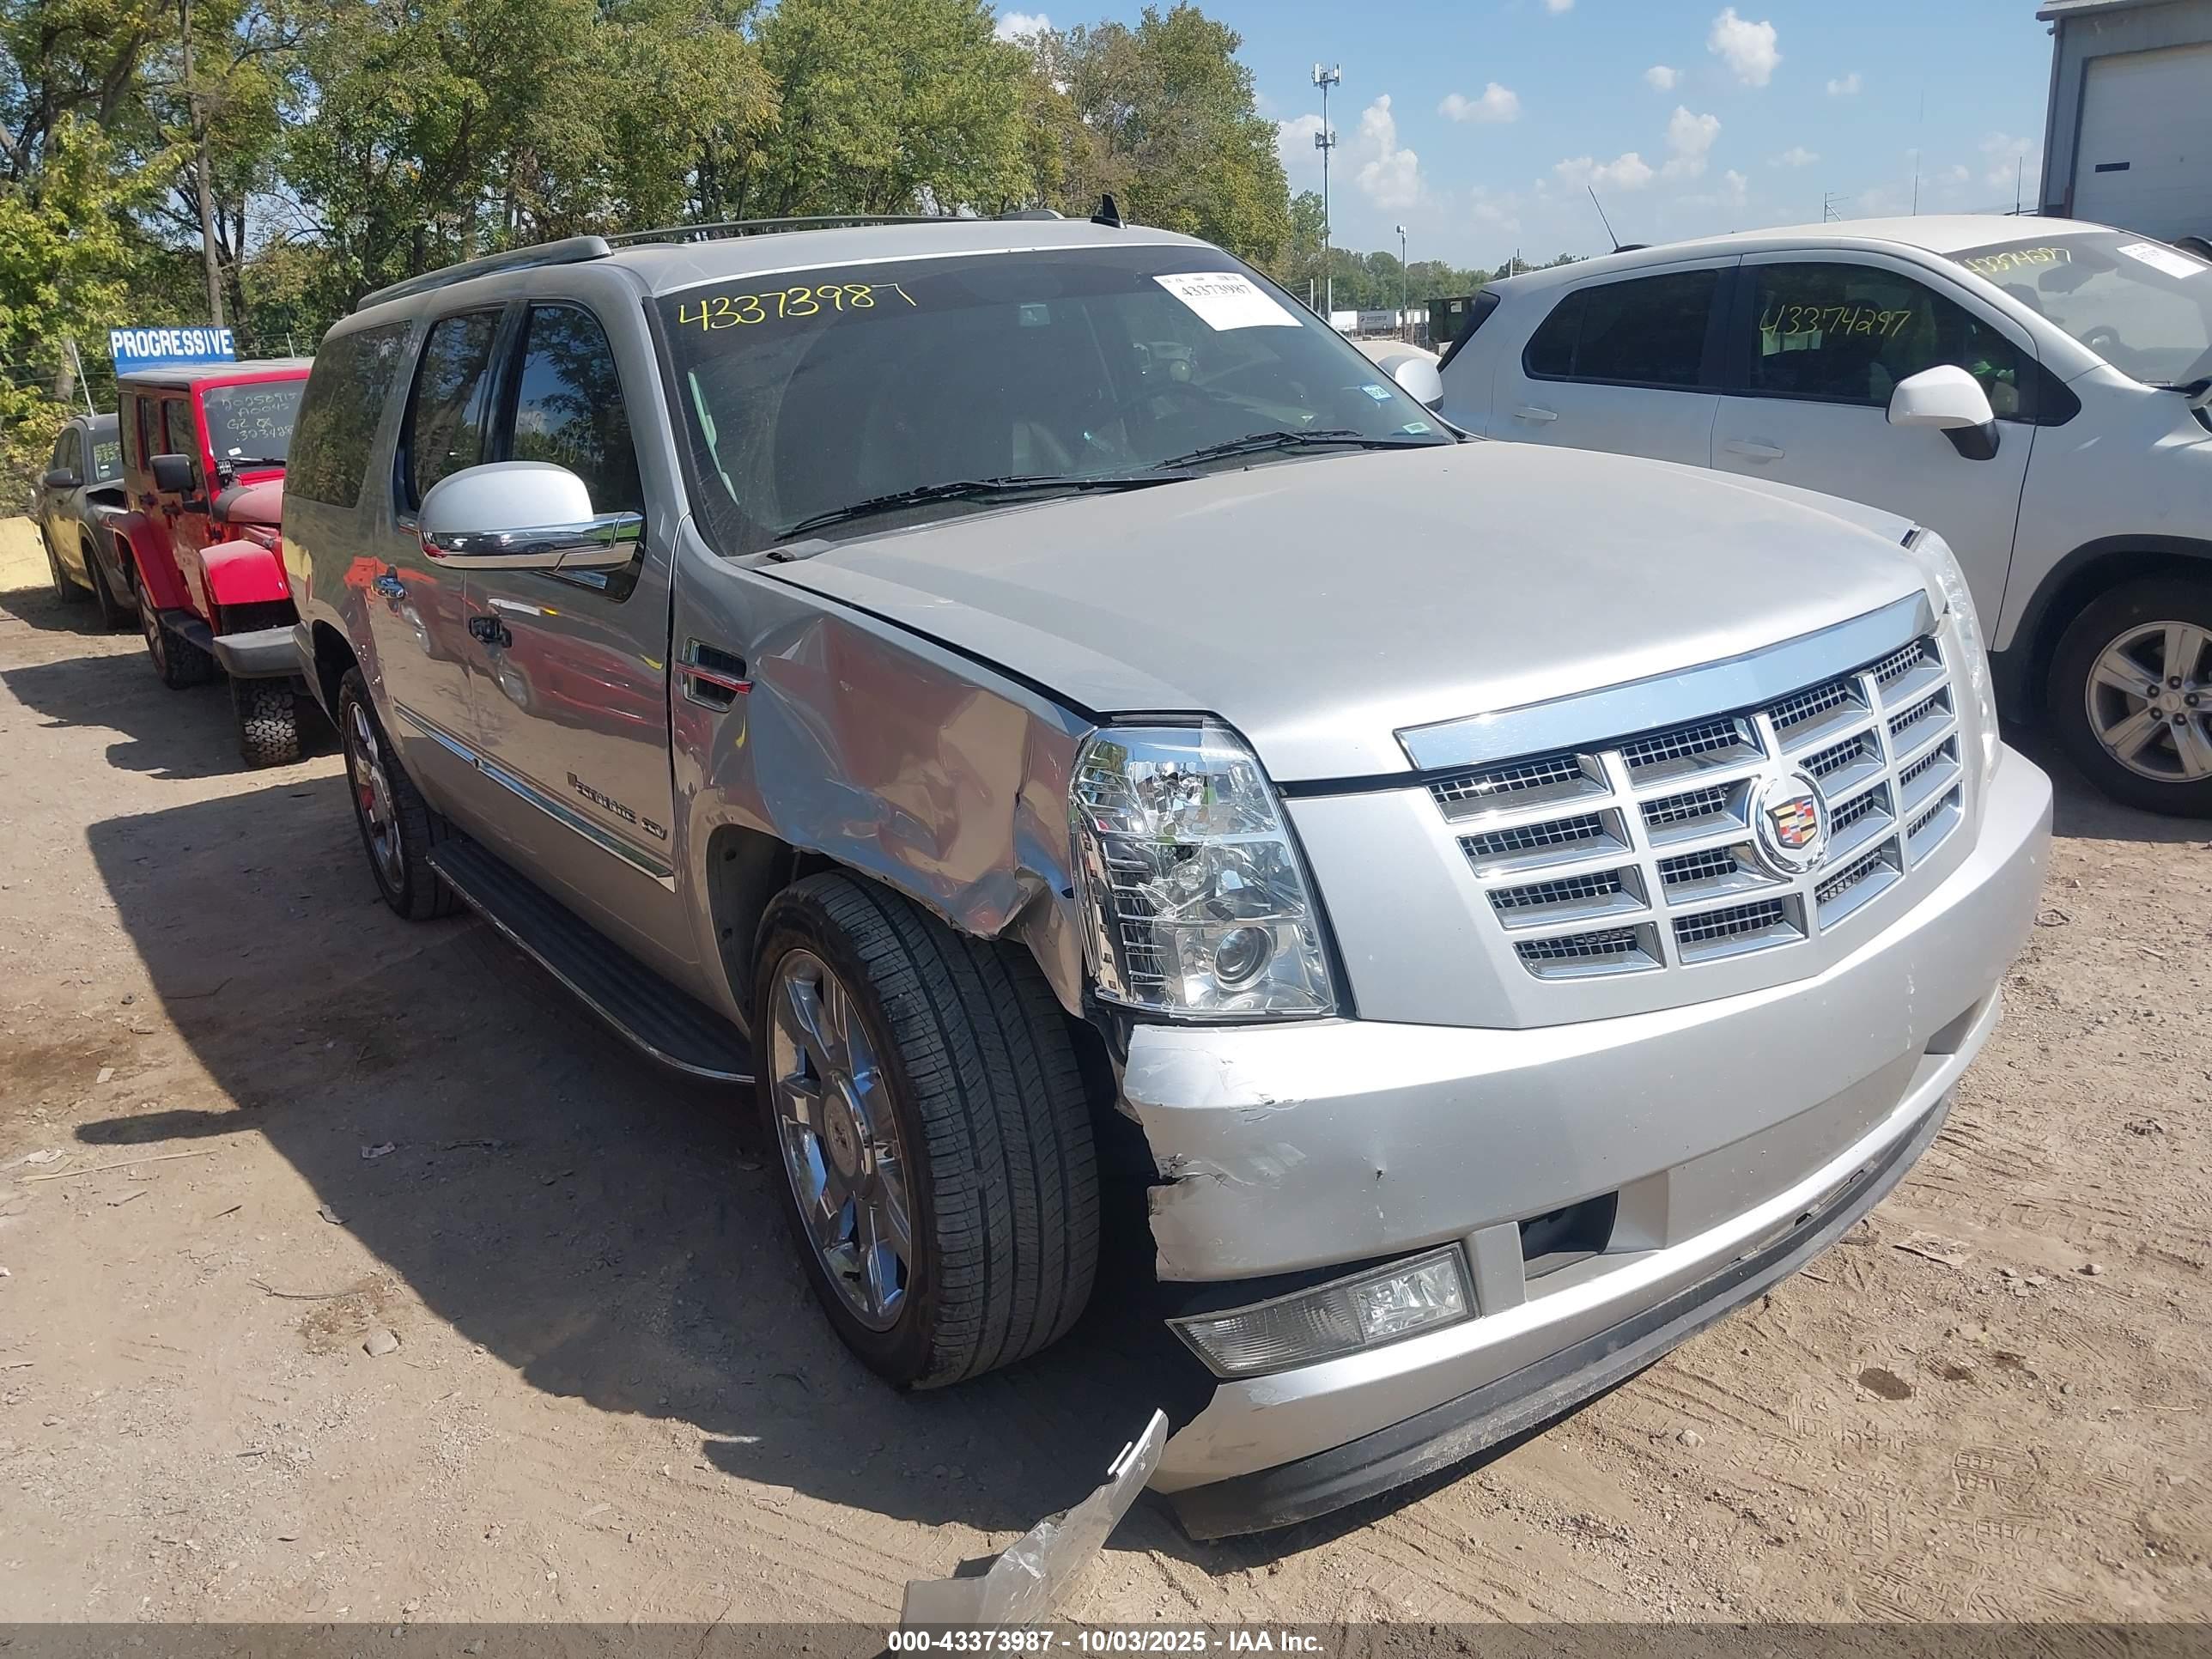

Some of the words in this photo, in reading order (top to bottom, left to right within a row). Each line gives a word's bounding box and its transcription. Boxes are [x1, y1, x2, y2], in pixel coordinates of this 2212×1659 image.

[1182, 283, 1252, 296] 43373987
[678, 282, 917, 331] 43373987
[1759, 304, 1911, 337] 43374297
[110, 329, 234, 358] PROGRESSIVE
